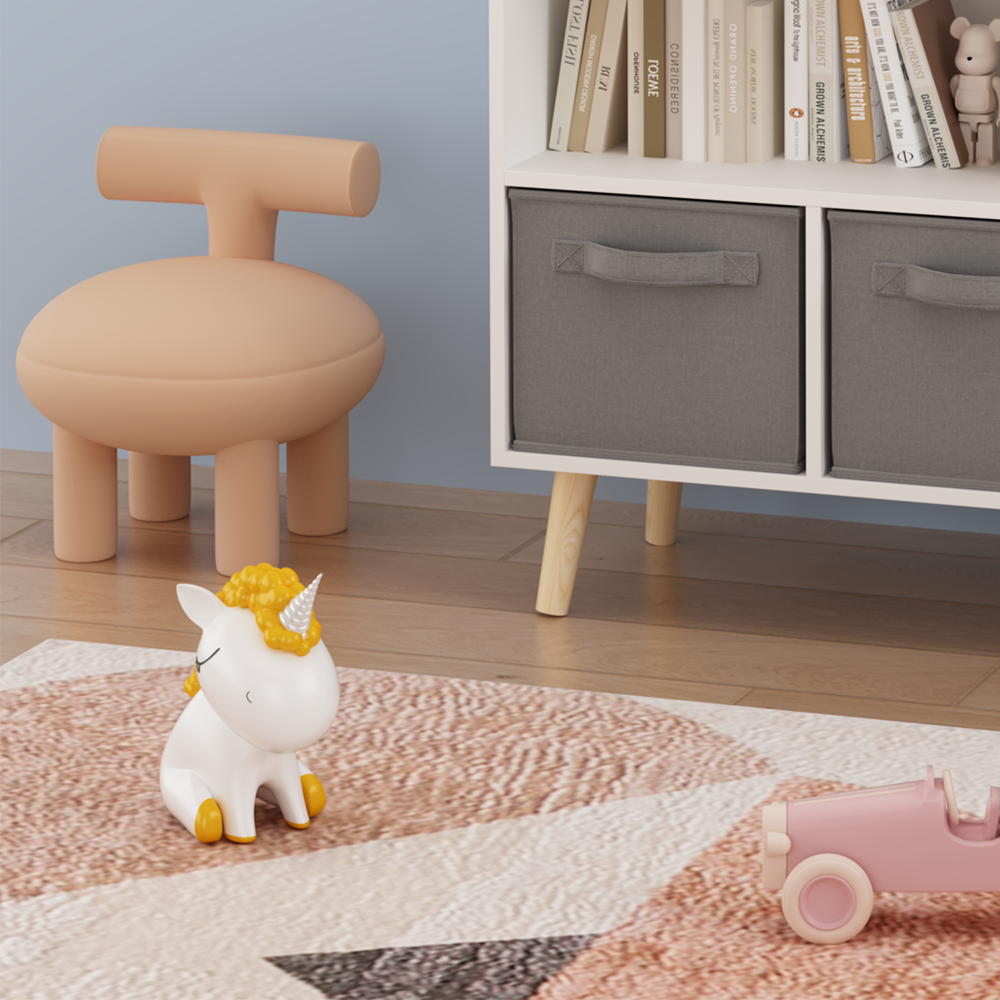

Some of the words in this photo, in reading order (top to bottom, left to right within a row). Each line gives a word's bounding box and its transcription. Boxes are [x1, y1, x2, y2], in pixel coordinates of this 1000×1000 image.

[815, 19, 827, 67] ALCHEMIST
[844, 36, 862, 54] arts
[895, 10, 912, 36] ROWN
[791, 41, 800, 62] Lighthouse
[903, 36, 925, 80] ALCHEMIST
[815, 81, 826, 115] GROWN
[847, 67, 867, 121] architecture
[816, 117, 826, 163] ALCHEMIS
[920, 93, 938, 125] GROWN
[930, 126, 952, 169] ALCHEMIS
